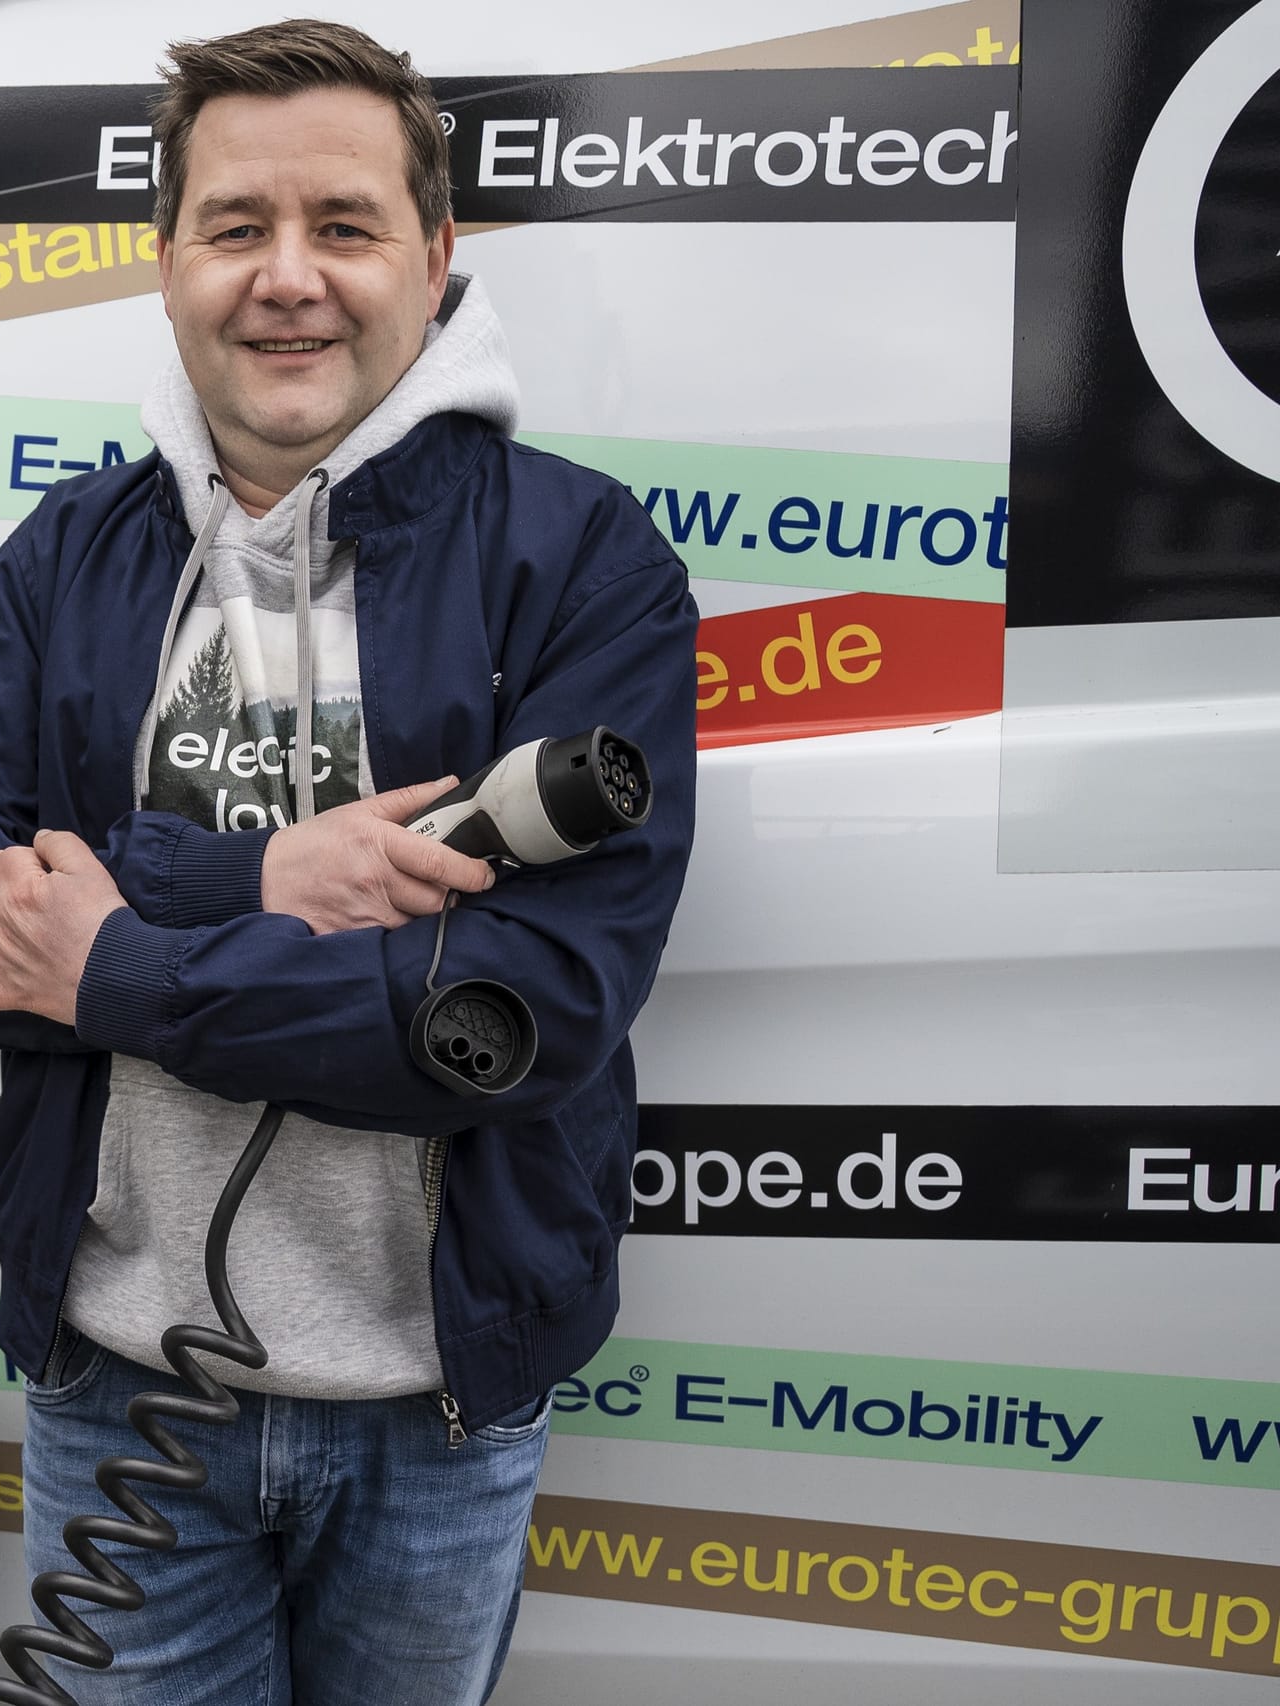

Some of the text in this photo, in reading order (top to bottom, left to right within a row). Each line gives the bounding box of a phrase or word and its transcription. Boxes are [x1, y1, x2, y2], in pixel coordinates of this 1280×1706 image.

[96, 125, 162, 190] E
[629, 1132, 964, 1225] ppe.de
[675, 1373, 1105, 1463] E-Mobility
[1191, 1414, 1280, 1464] w
[527, 1524, 1280, 1665] ww.eurotec-grup
